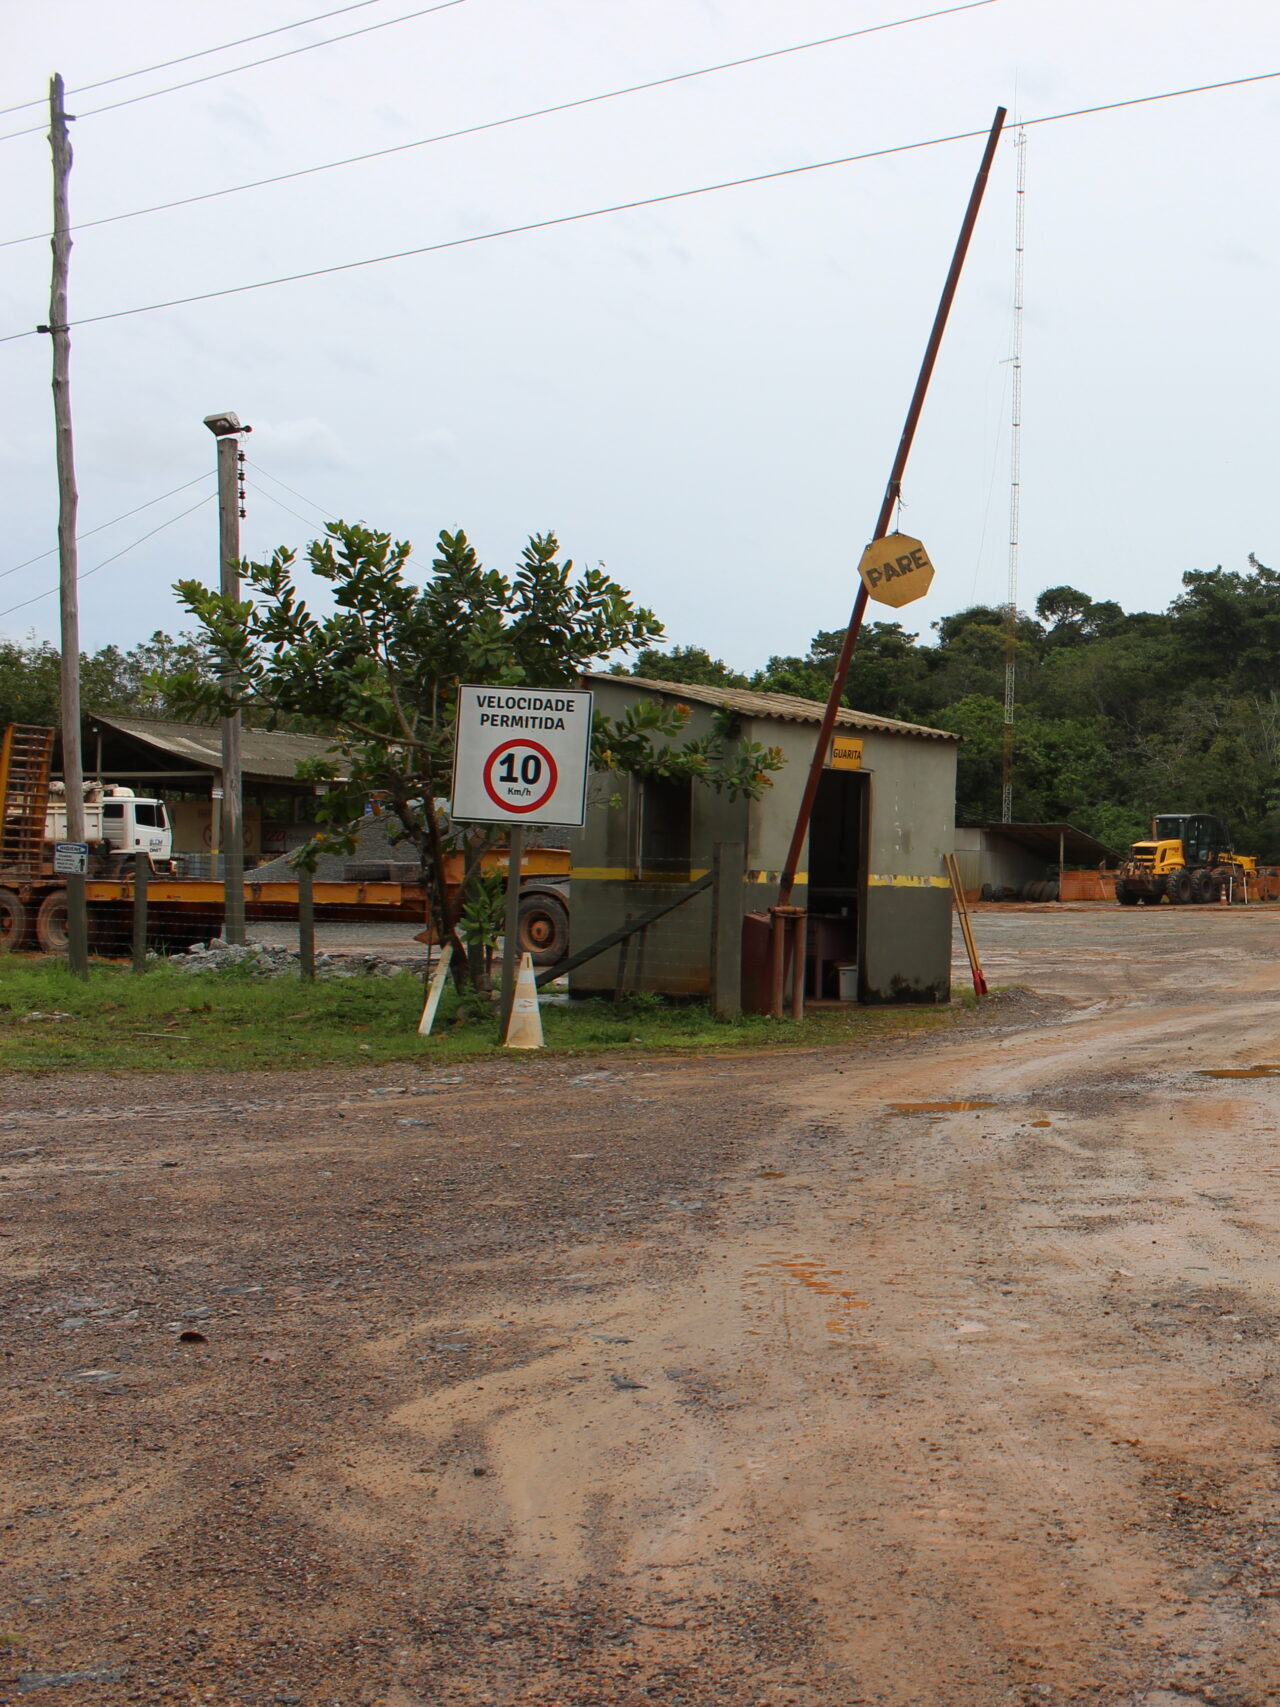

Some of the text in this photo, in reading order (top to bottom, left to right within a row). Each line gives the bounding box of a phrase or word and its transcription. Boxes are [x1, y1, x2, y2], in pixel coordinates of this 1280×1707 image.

[866, 548, 929, 588] PARE
[476, 695, 575, 712] VELOCIDADE
[480, 713, 565, 730] PERMITIDA
[832, 748, 862, 760] GUARITA
[499, 753, 542, 785] 10
[507, 787, 532, 797] Km/h
